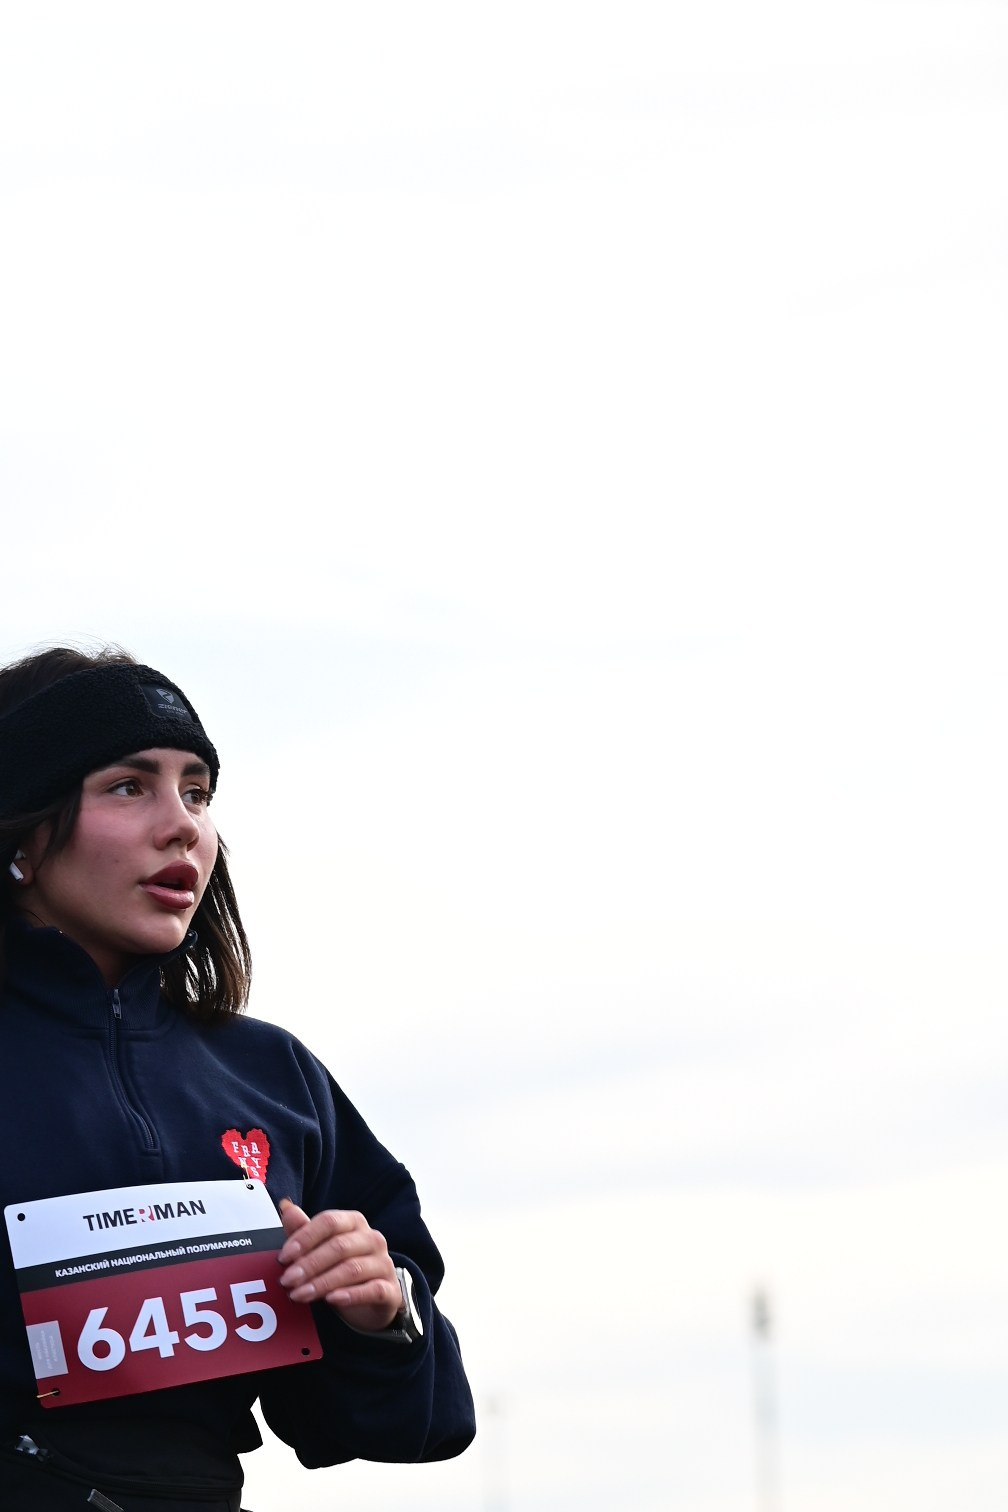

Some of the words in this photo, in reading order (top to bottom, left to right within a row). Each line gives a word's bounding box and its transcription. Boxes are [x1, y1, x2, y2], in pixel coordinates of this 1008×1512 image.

[54, 1258, 110, 1278] КАЗАНСКИЙ
[110, 1246, 186, 1268] НАЦИОНАЛЬНЫЙ
[186, 1237, 253, 1254] ПОЛУМАРАФОН
[77, 1279, 278, 1371] 6455
